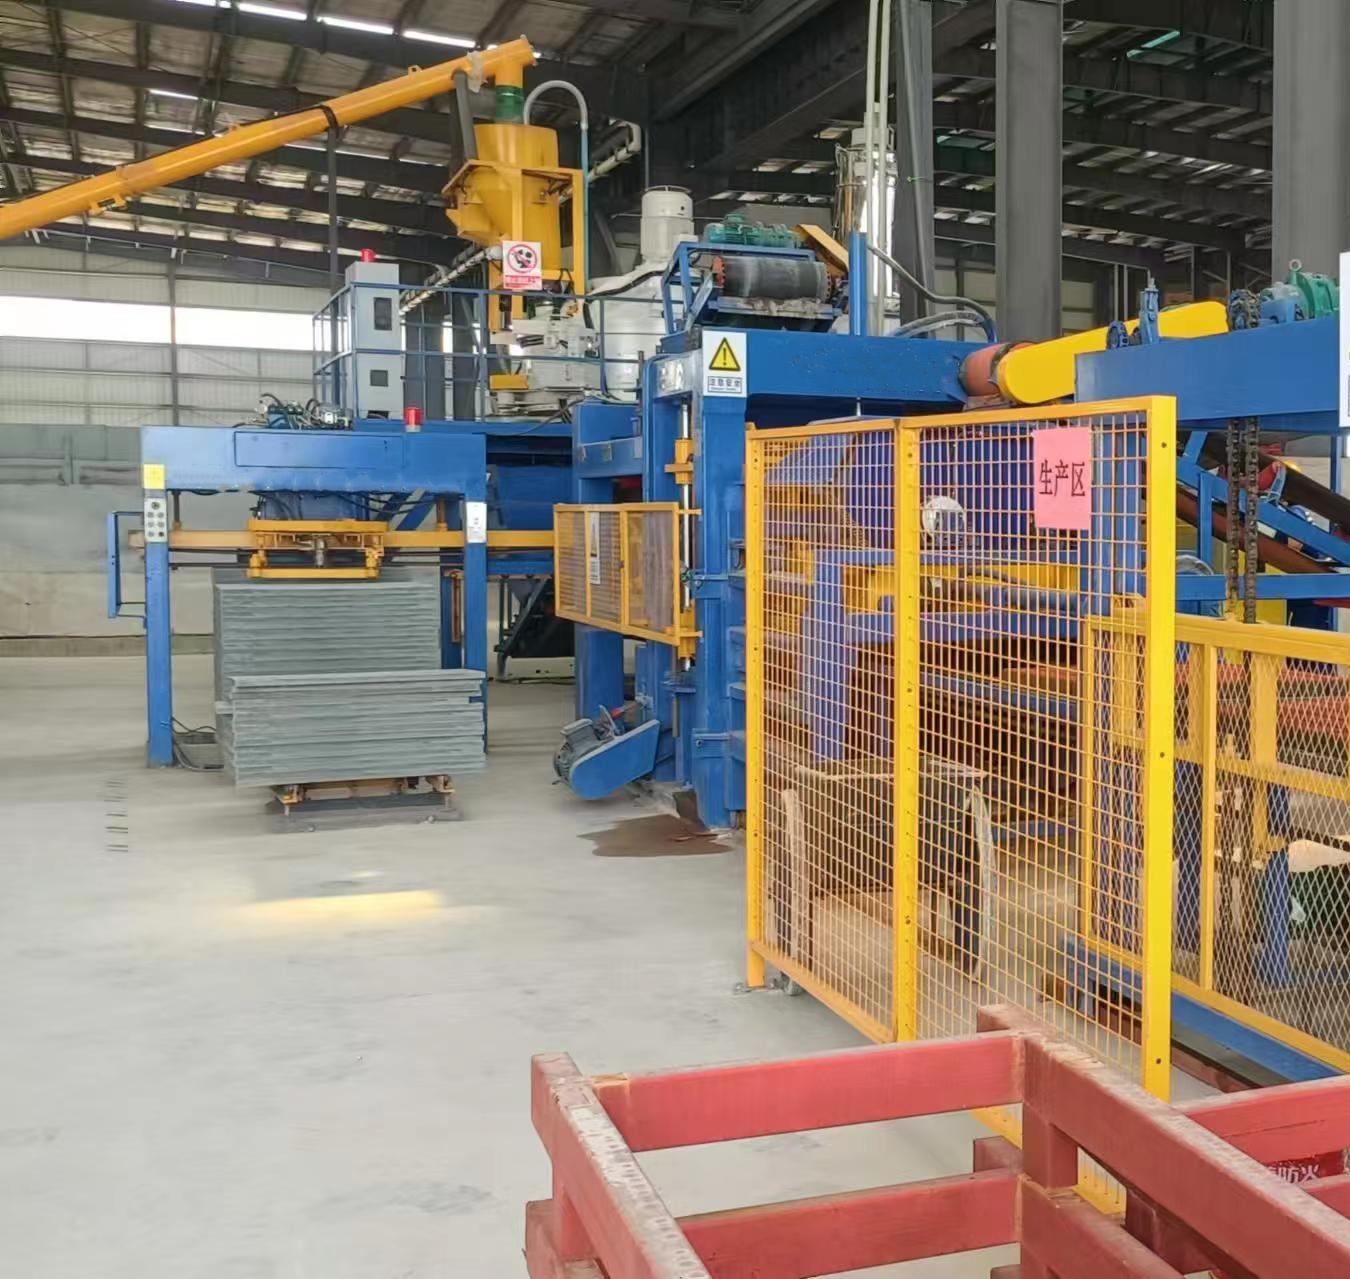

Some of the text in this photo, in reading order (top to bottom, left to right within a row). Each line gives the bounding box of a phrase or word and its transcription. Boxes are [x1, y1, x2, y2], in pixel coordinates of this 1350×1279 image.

[1039, 459, 1085, 496] 生产区
[1267, 1161, 1320, 1184] 防火
